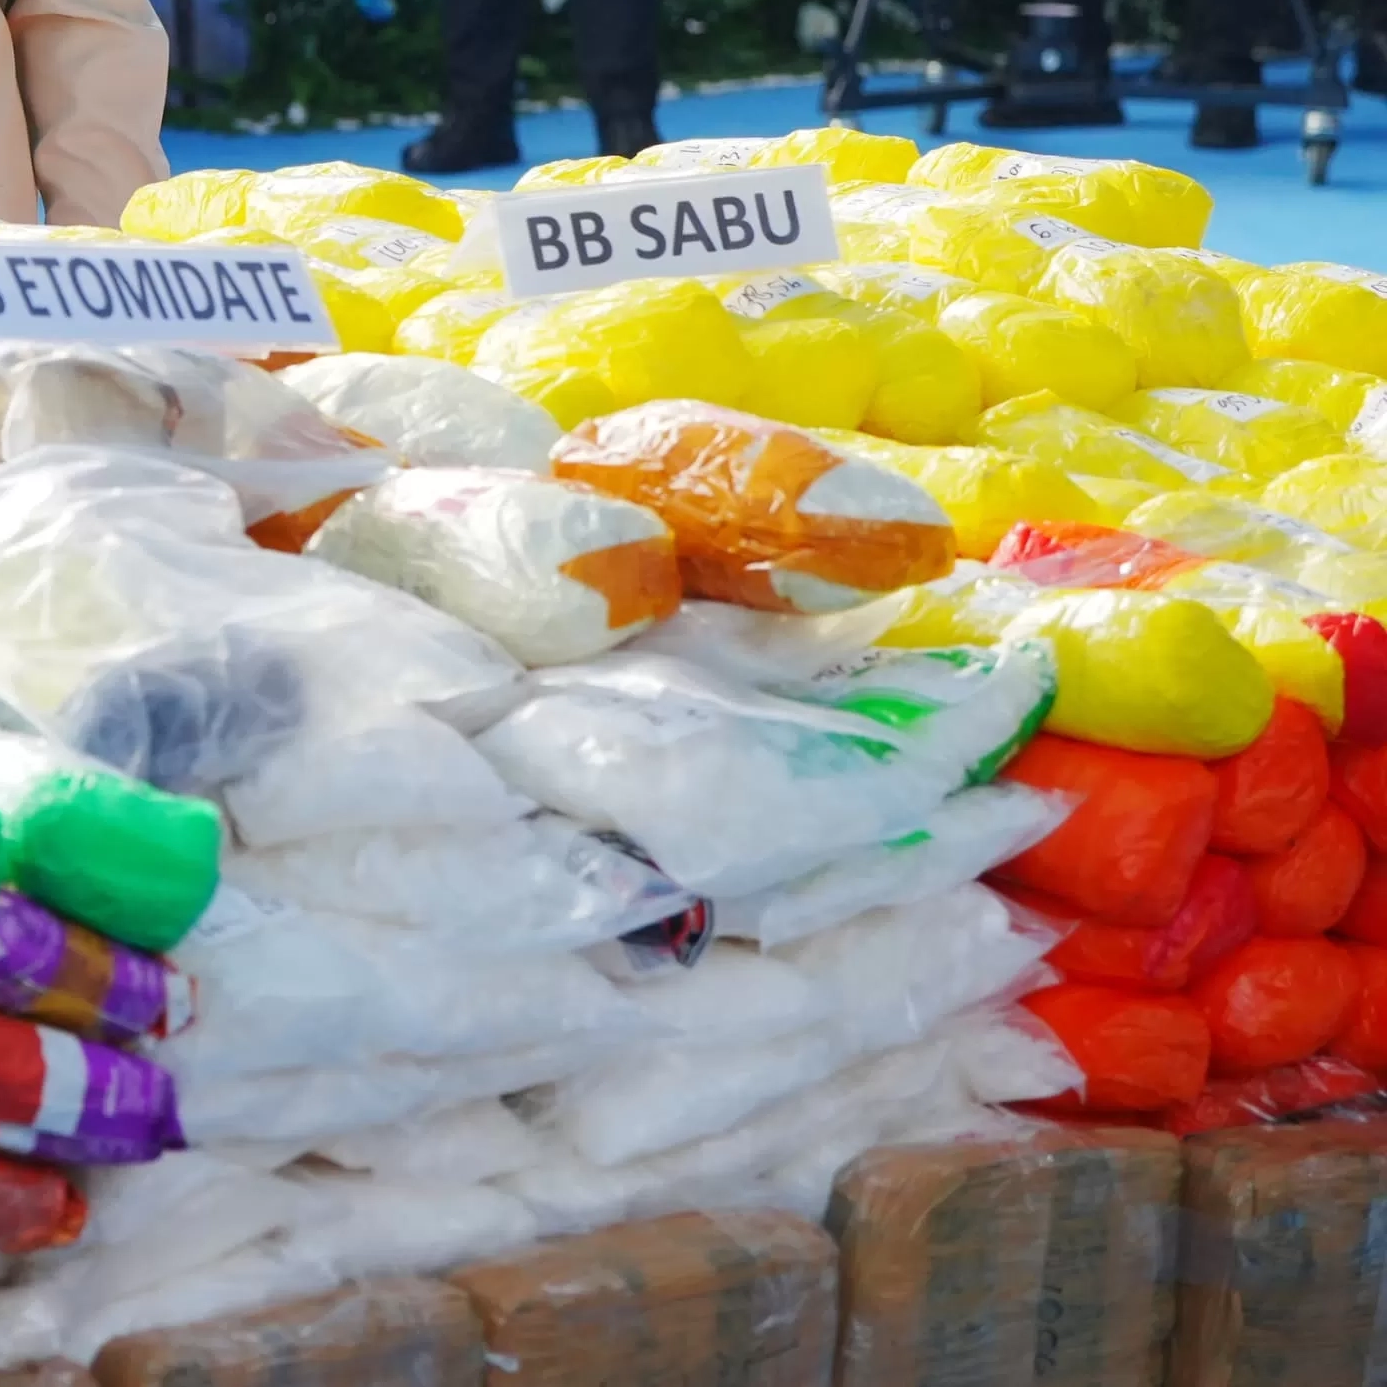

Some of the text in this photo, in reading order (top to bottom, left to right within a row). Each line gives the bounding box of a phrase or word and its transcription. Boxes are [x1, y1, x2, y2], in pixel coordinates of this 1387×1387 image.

[525, 189, 801, 272] BB SABU
[5, 257, 313, 324] ETOMIDATE
